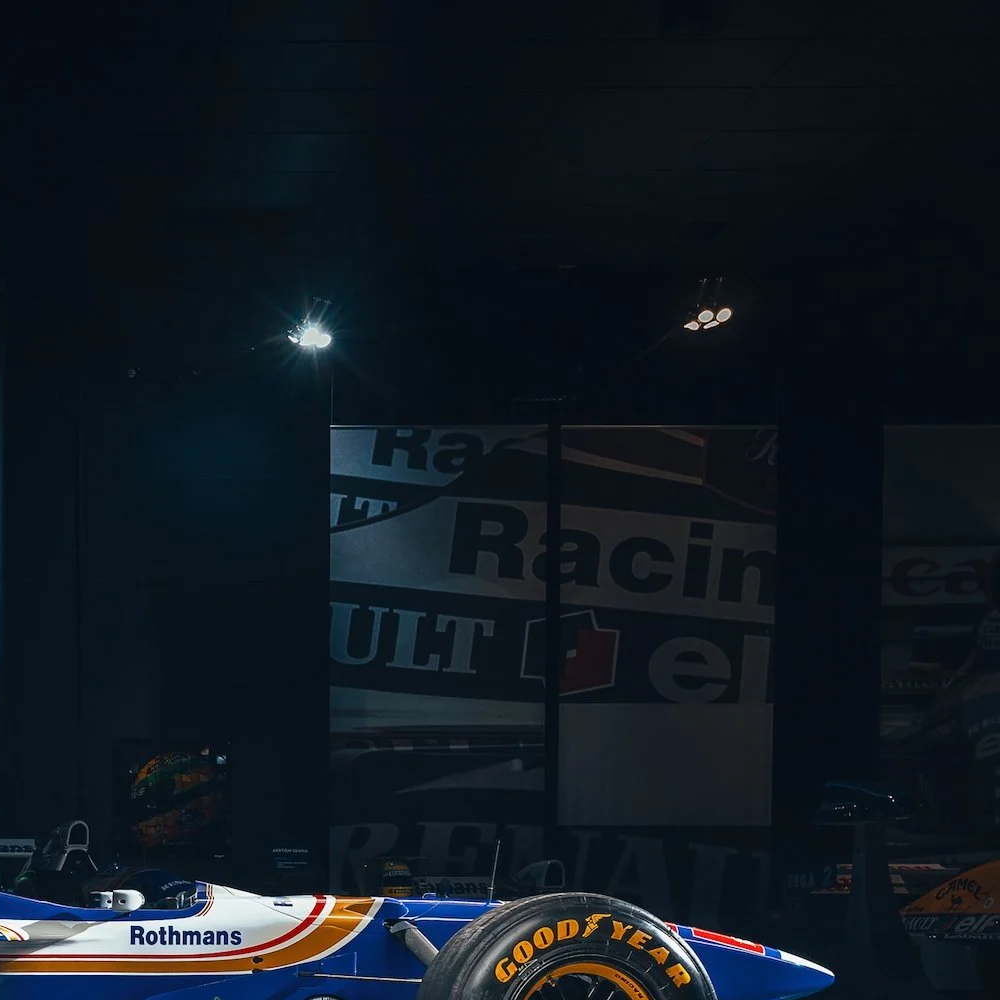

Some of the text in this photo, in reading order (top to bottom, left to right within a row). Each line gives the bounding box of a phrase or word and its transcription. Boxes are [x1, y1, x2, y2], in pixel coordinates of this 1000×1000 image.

[330, 601, 496, 674] ULT
[936, 879, 982, 901] CAMEL
[130, 926, 243, 946] Rothmans
